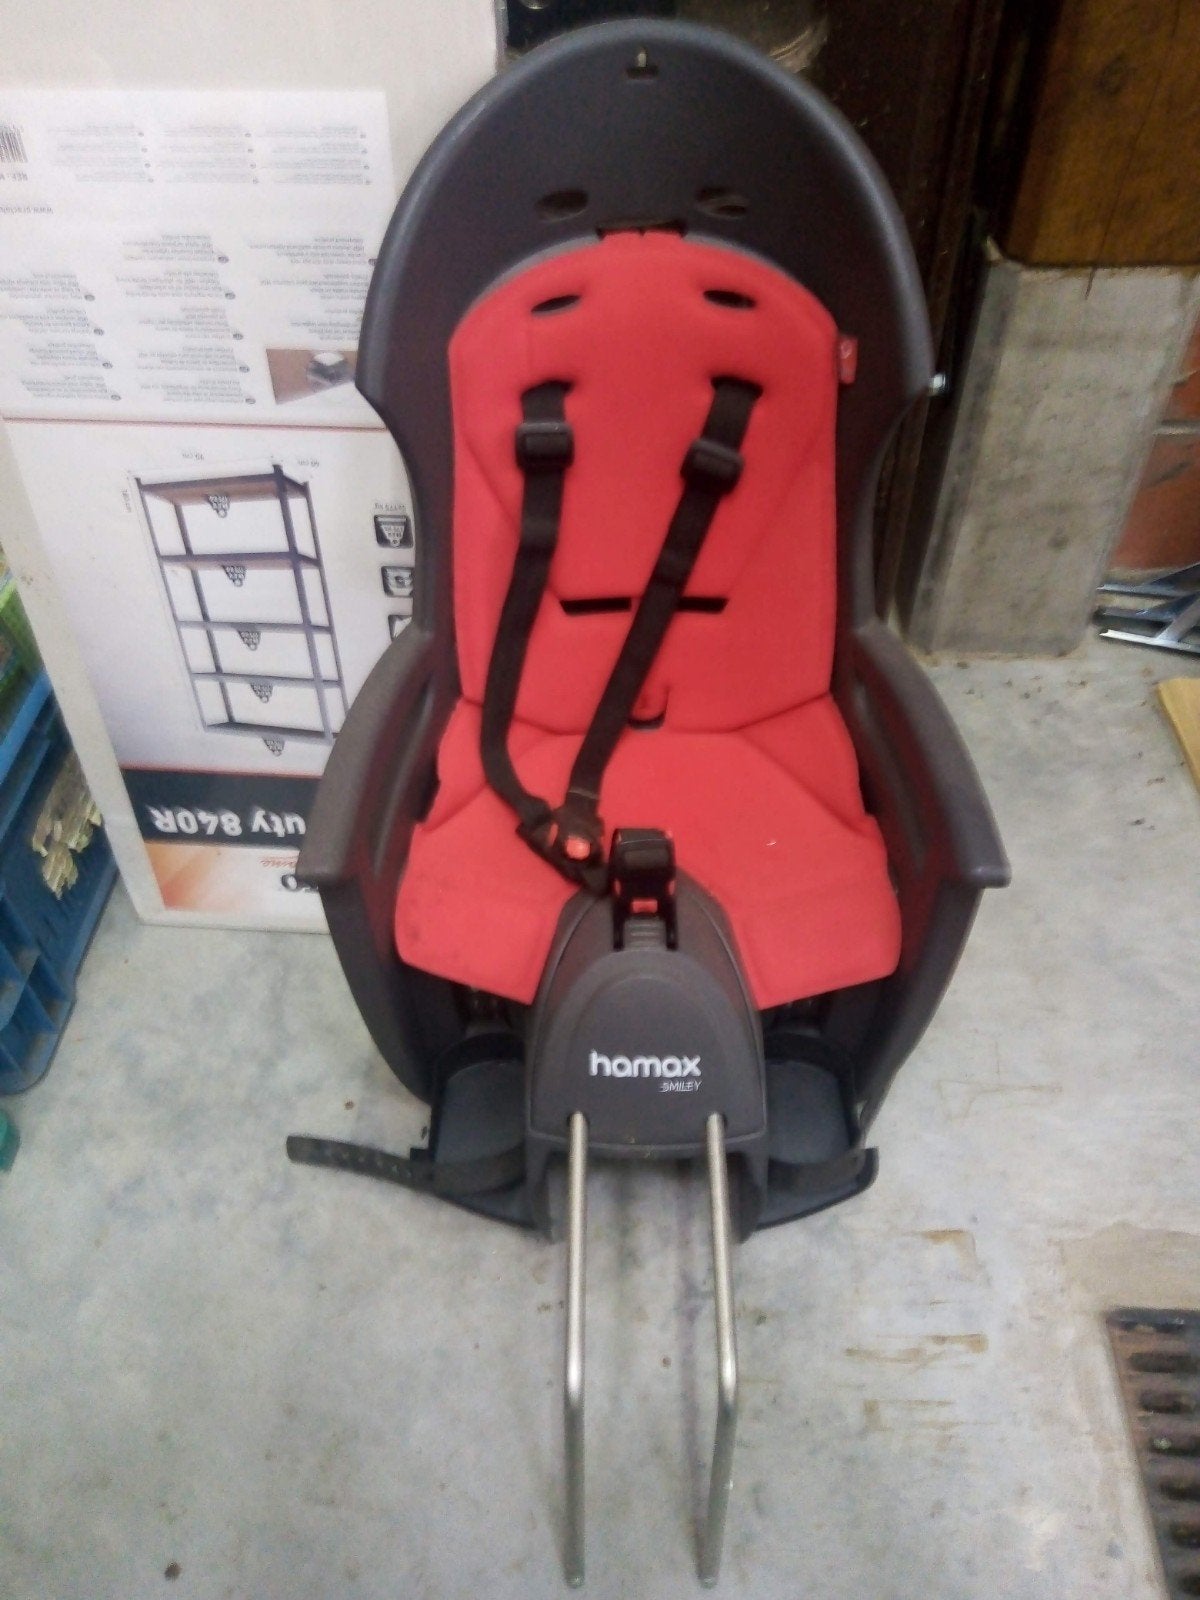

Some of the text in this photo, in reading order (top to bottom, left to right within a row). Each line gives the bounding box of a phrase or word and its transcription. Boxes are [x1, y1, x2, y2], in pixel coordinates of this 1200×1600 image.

[149, 807, 242, 837] 840R
[588, 1049, 702, 1078] hamax
[659, 1081, 703, 1092] SMILEY
